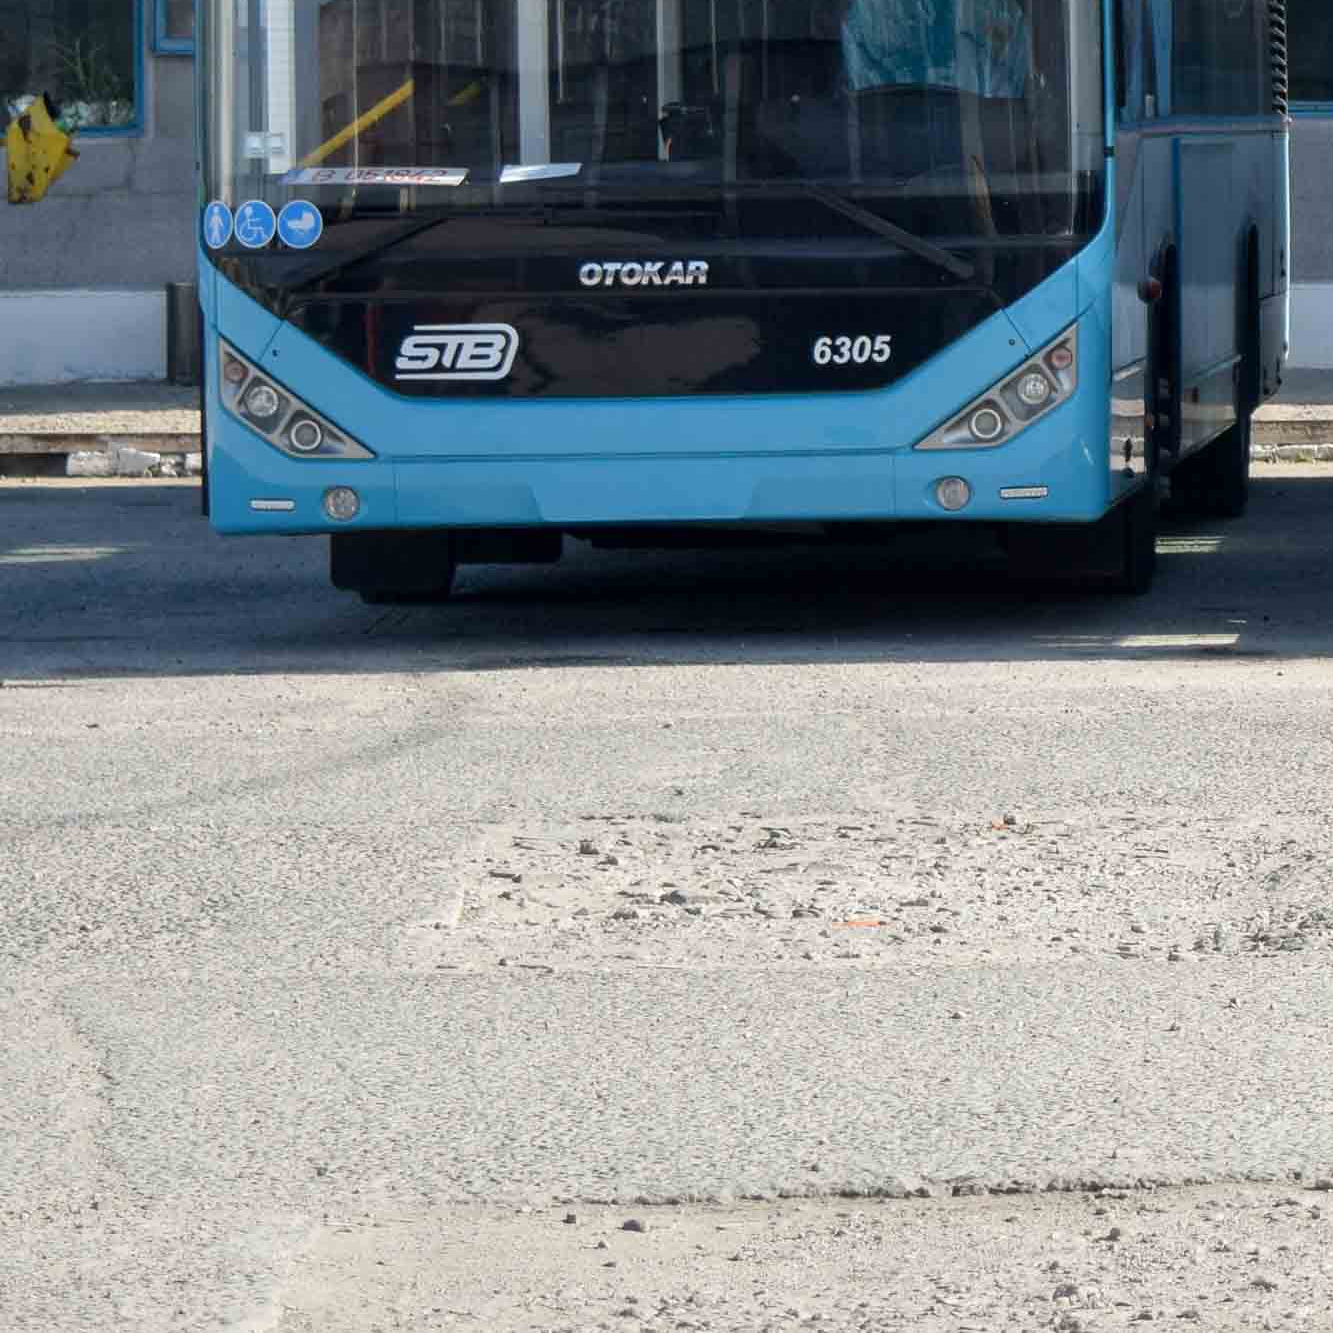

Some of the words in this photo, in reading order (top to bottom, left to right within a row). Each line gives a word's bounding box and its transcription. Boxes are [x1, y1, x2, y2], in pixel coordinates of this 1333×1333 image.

[578, 260, 709, 287] OTOKAR
[395, 331, 507, 371] STB
[812, 334, 892, 366] 6305
